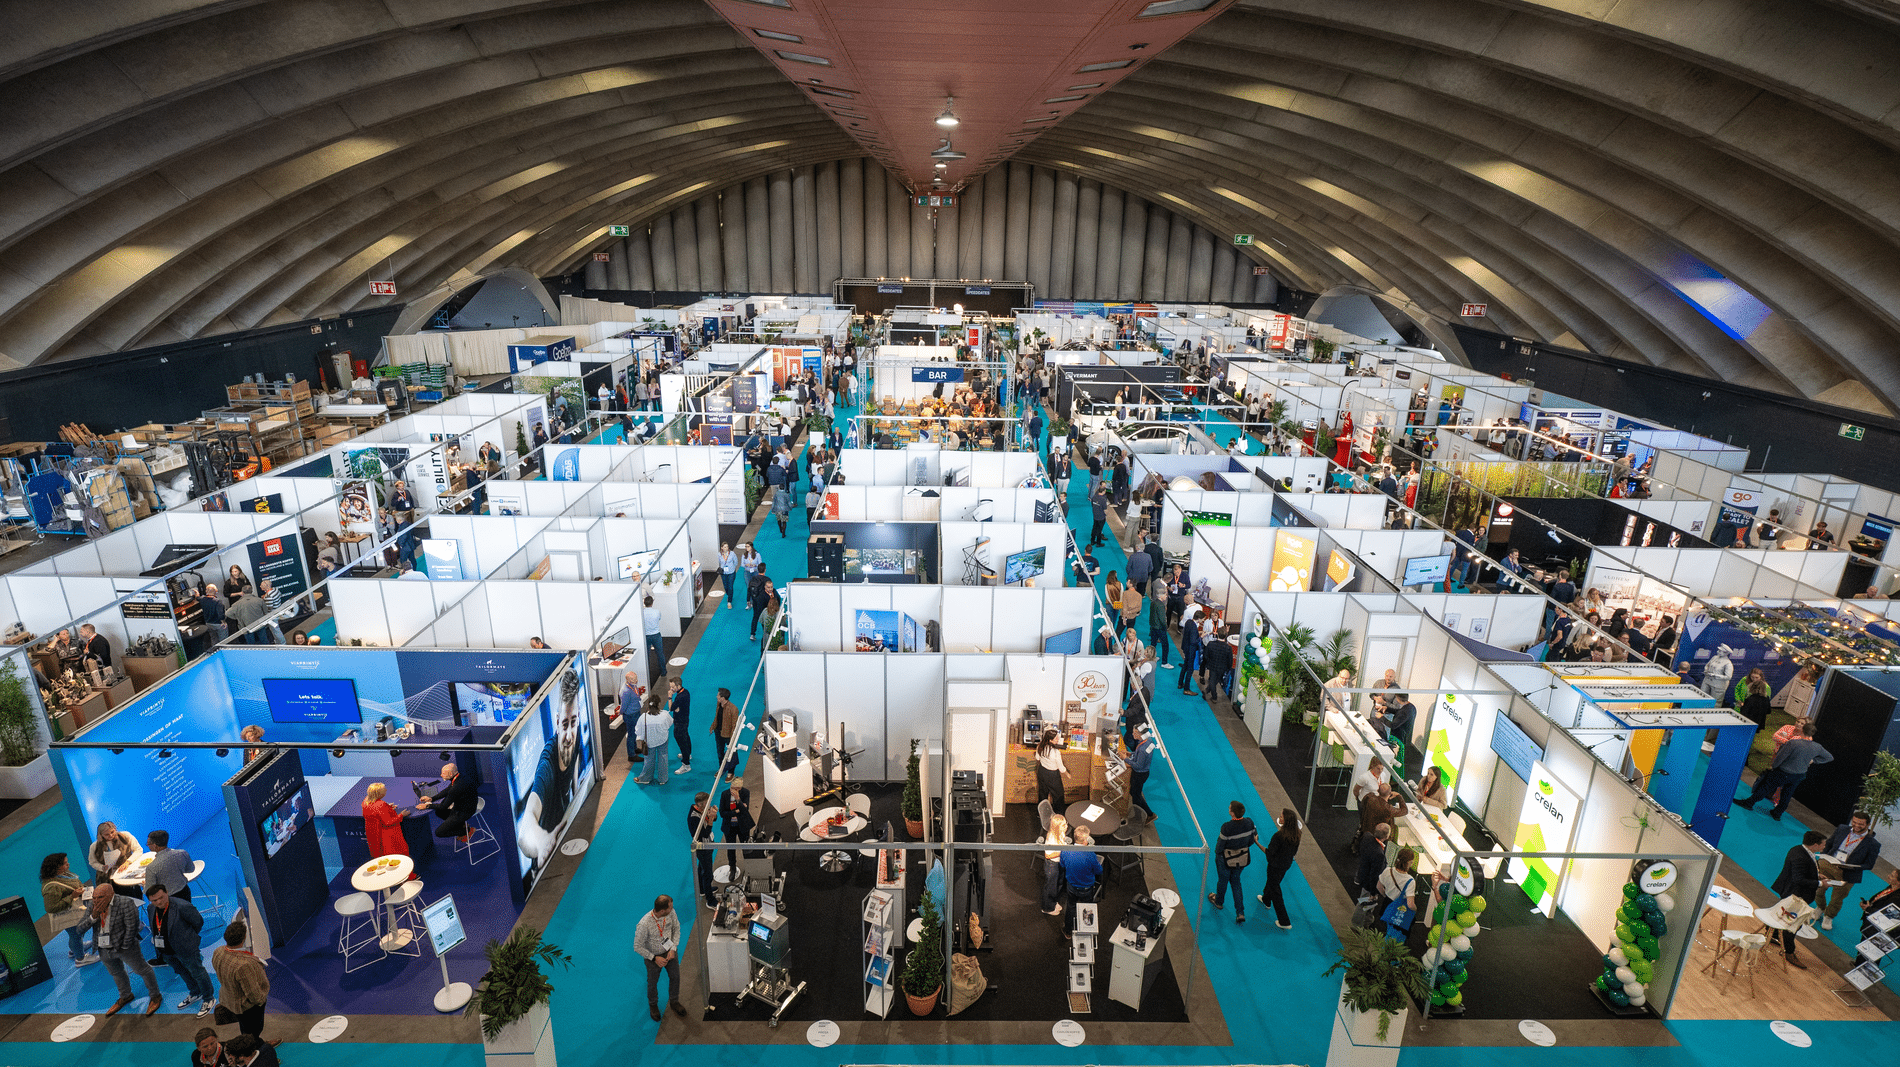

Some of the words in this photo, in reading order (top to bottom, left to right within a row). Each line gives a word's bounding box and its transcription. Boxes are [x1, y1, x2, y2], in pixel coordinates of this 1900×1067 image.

[928, 372, 948, 380] BAR
[1732, 492, 1752, 503] go
[1442, 702, 1463, 726] crelan
[1534, 792, 1564, 824] crelan
